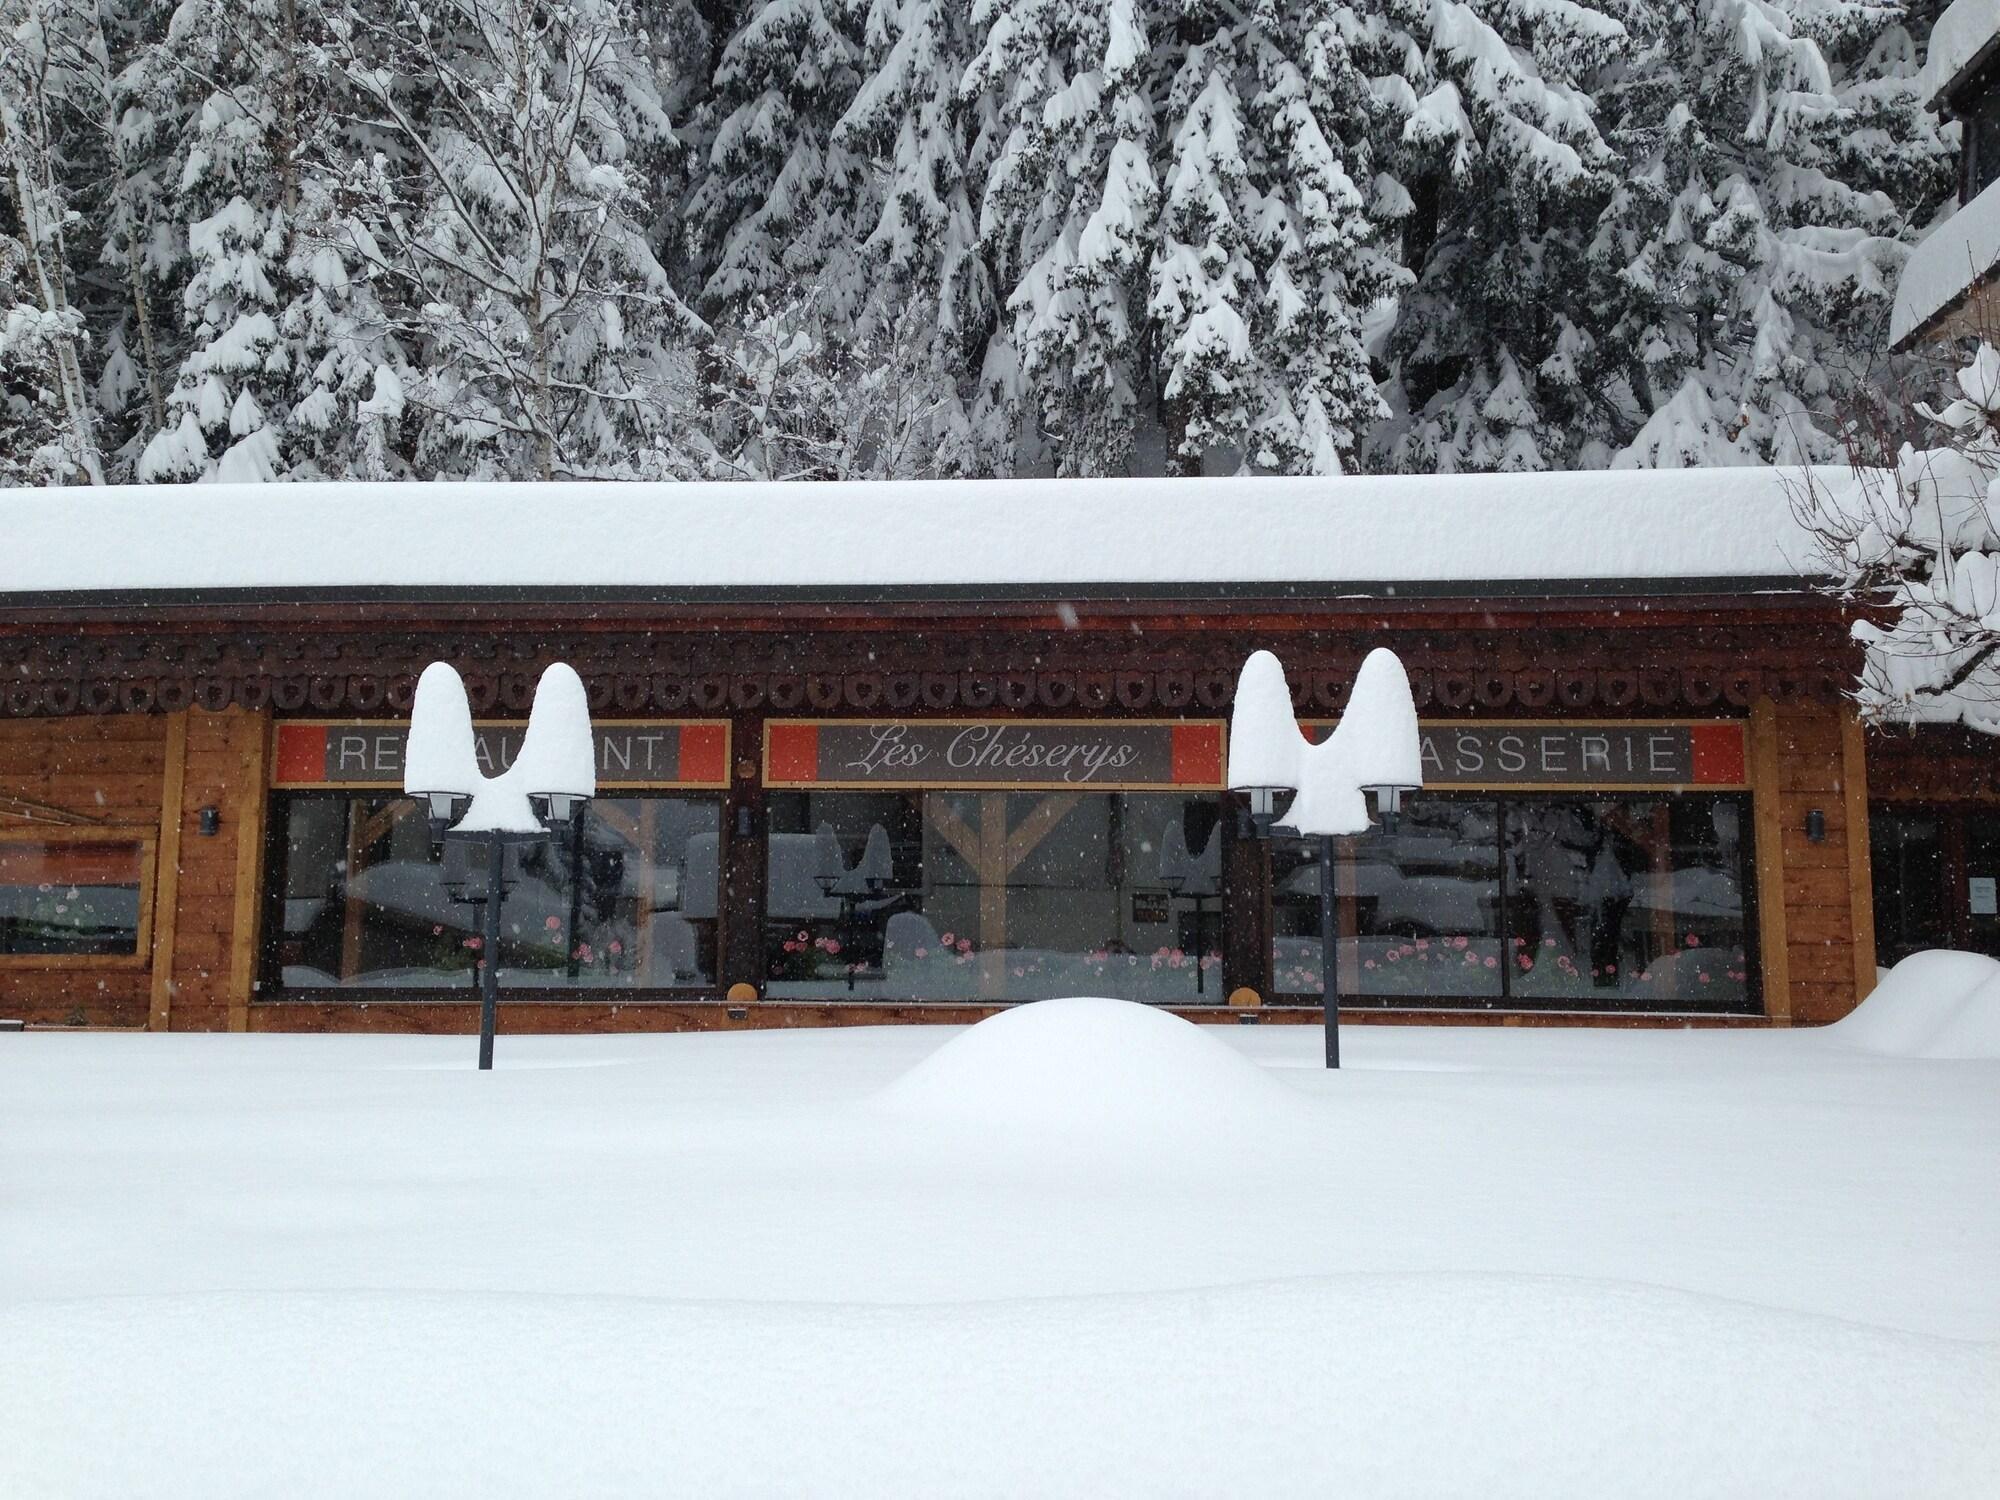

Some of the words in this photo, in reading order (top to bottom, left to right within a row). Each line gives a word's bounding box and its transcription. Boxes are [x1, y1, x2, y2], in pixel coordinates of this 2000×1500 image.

[340, 736, 663, 771] REAUNT
[847, 725, 932, 775] Les
[946, 725, 1139, 782] Chéserys
[1421, 736, 1677, 772] ASSERIE
